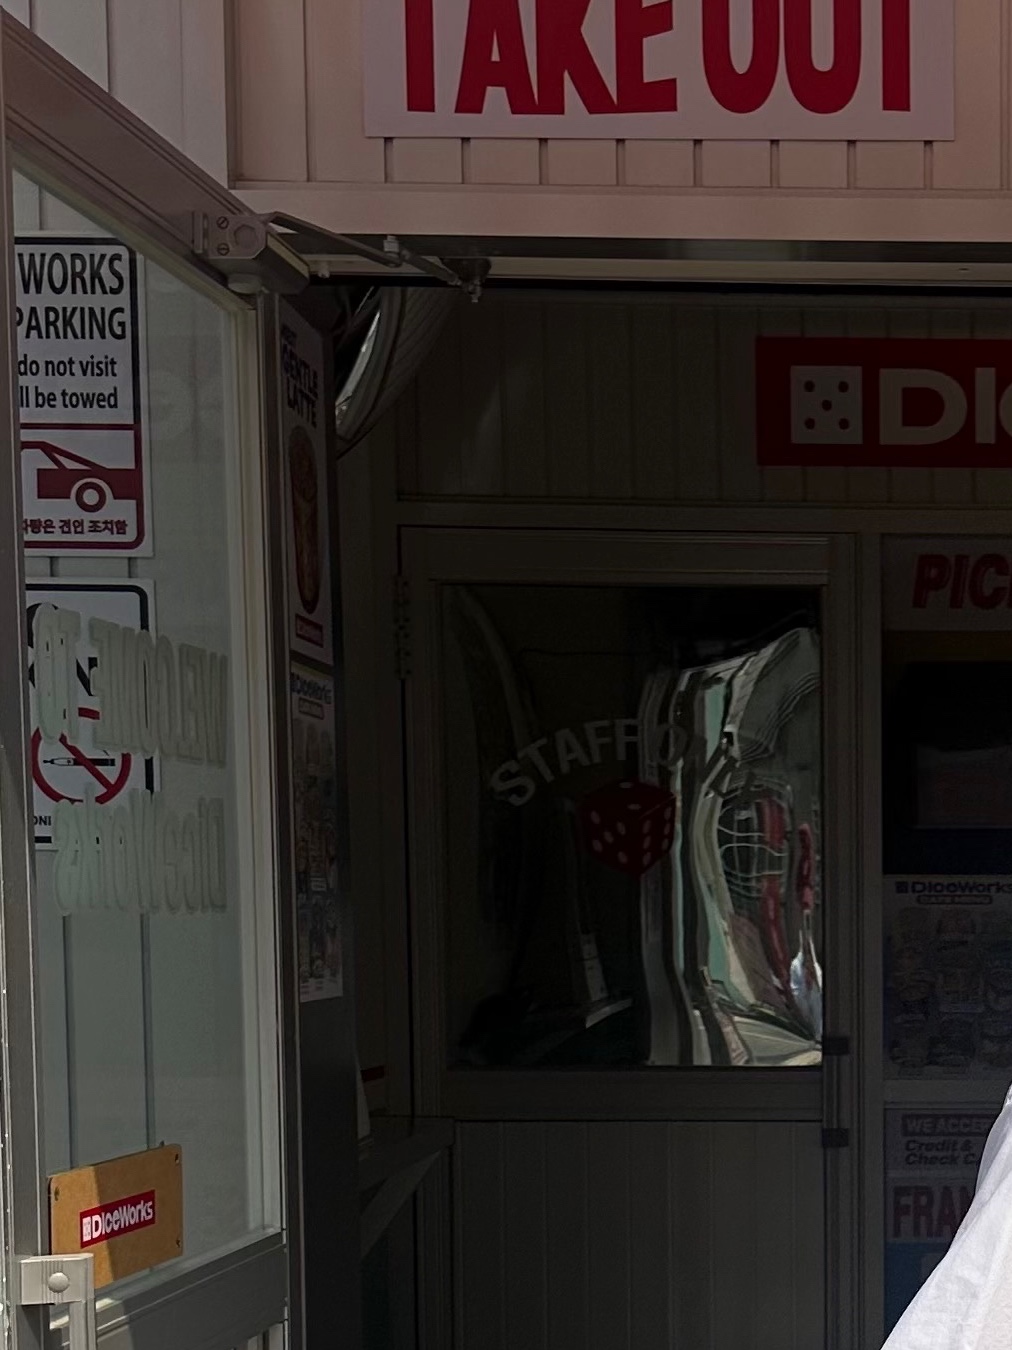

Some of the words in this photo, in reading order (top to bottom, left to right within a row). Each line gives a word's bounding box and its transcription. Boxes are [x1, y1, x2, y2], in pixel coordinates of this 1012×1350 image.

[17, 252, 125, 295] WORKS
[49, 358, 75, 377] not
[79, 354, 117, 377] visit
[36, 386, 56, 409] be
[61, 386, 118, 409] towed
[490, 718, 641, 806] STAFF
[905, 1139, 958, 1152] Credit
[905, 1153, 959, 1165] Check
